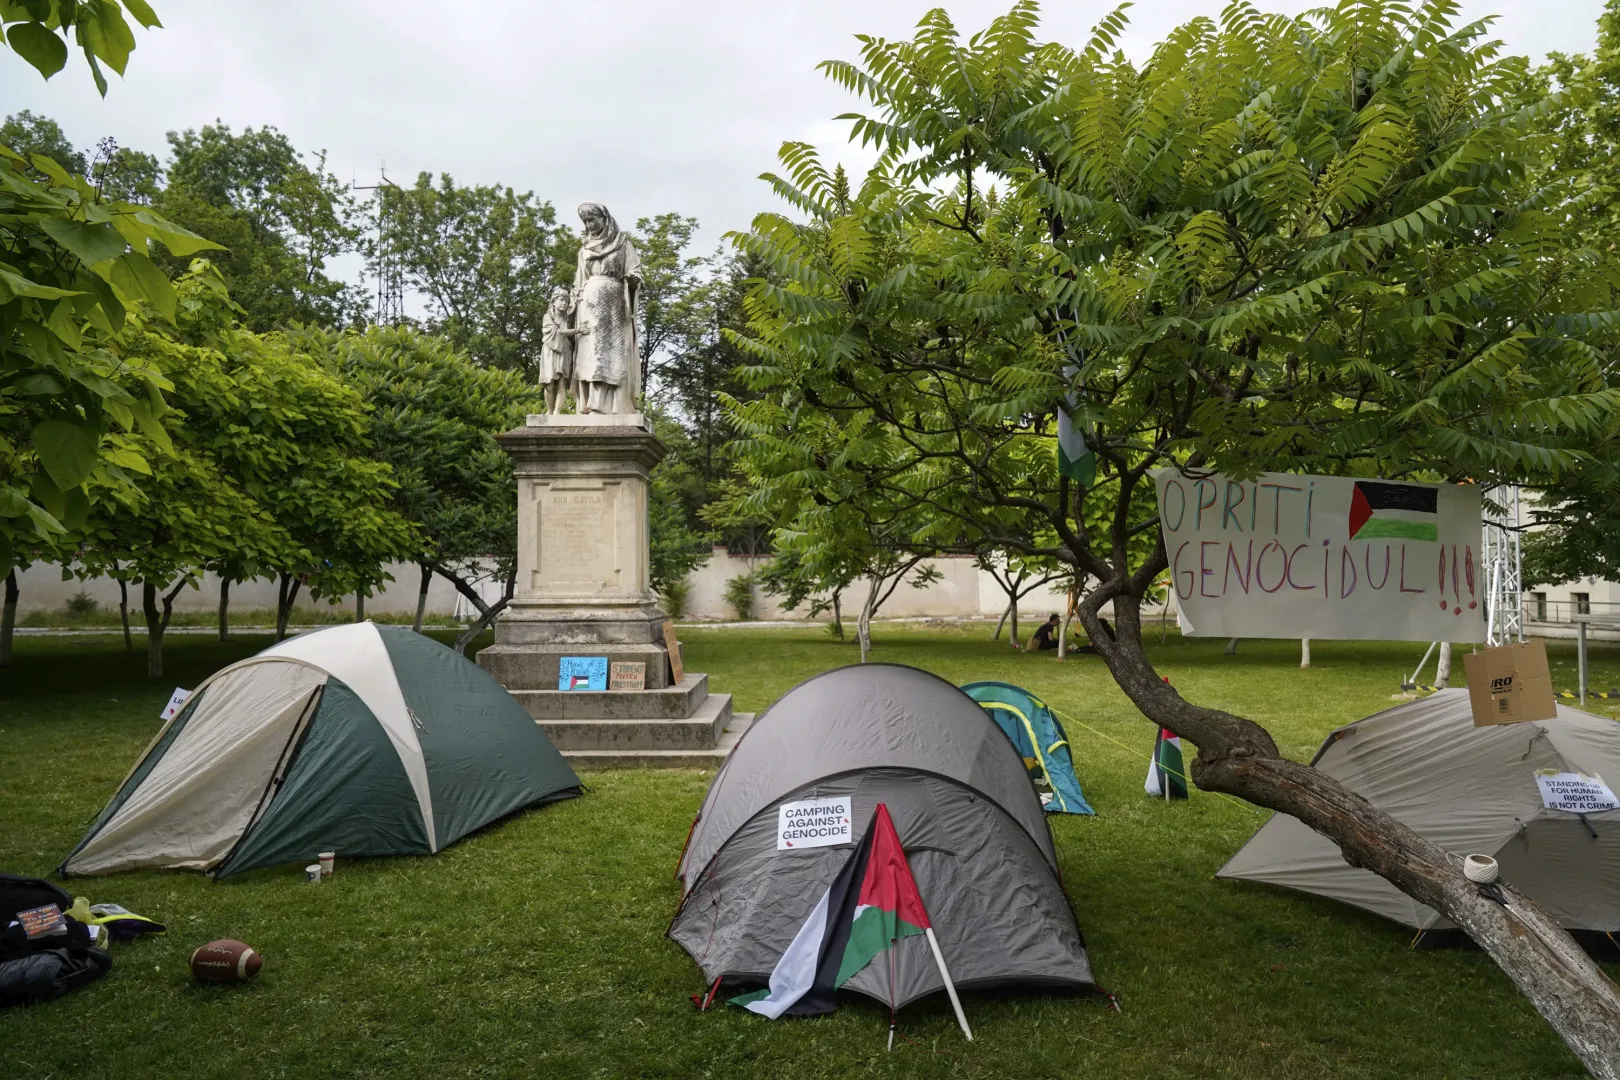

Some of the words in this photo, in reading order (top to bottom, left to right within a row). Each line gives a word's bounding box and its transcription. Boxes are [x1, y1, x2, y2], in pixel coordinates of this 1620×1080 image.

[1545, 780, 1589, 788] STANDING
[1570, 787, 1603, 795] HUMAN
[1563, 794, 1597, 802] RIGHTS
[1549, 801, 1558, 809] IS
[1586, 802, 1615, 810] CRIME
[785, 805, 845, 818] CAMPING
[787, 816, 843, 828] AGAINST
[782, 826, 848, 840] GENOCIDE
